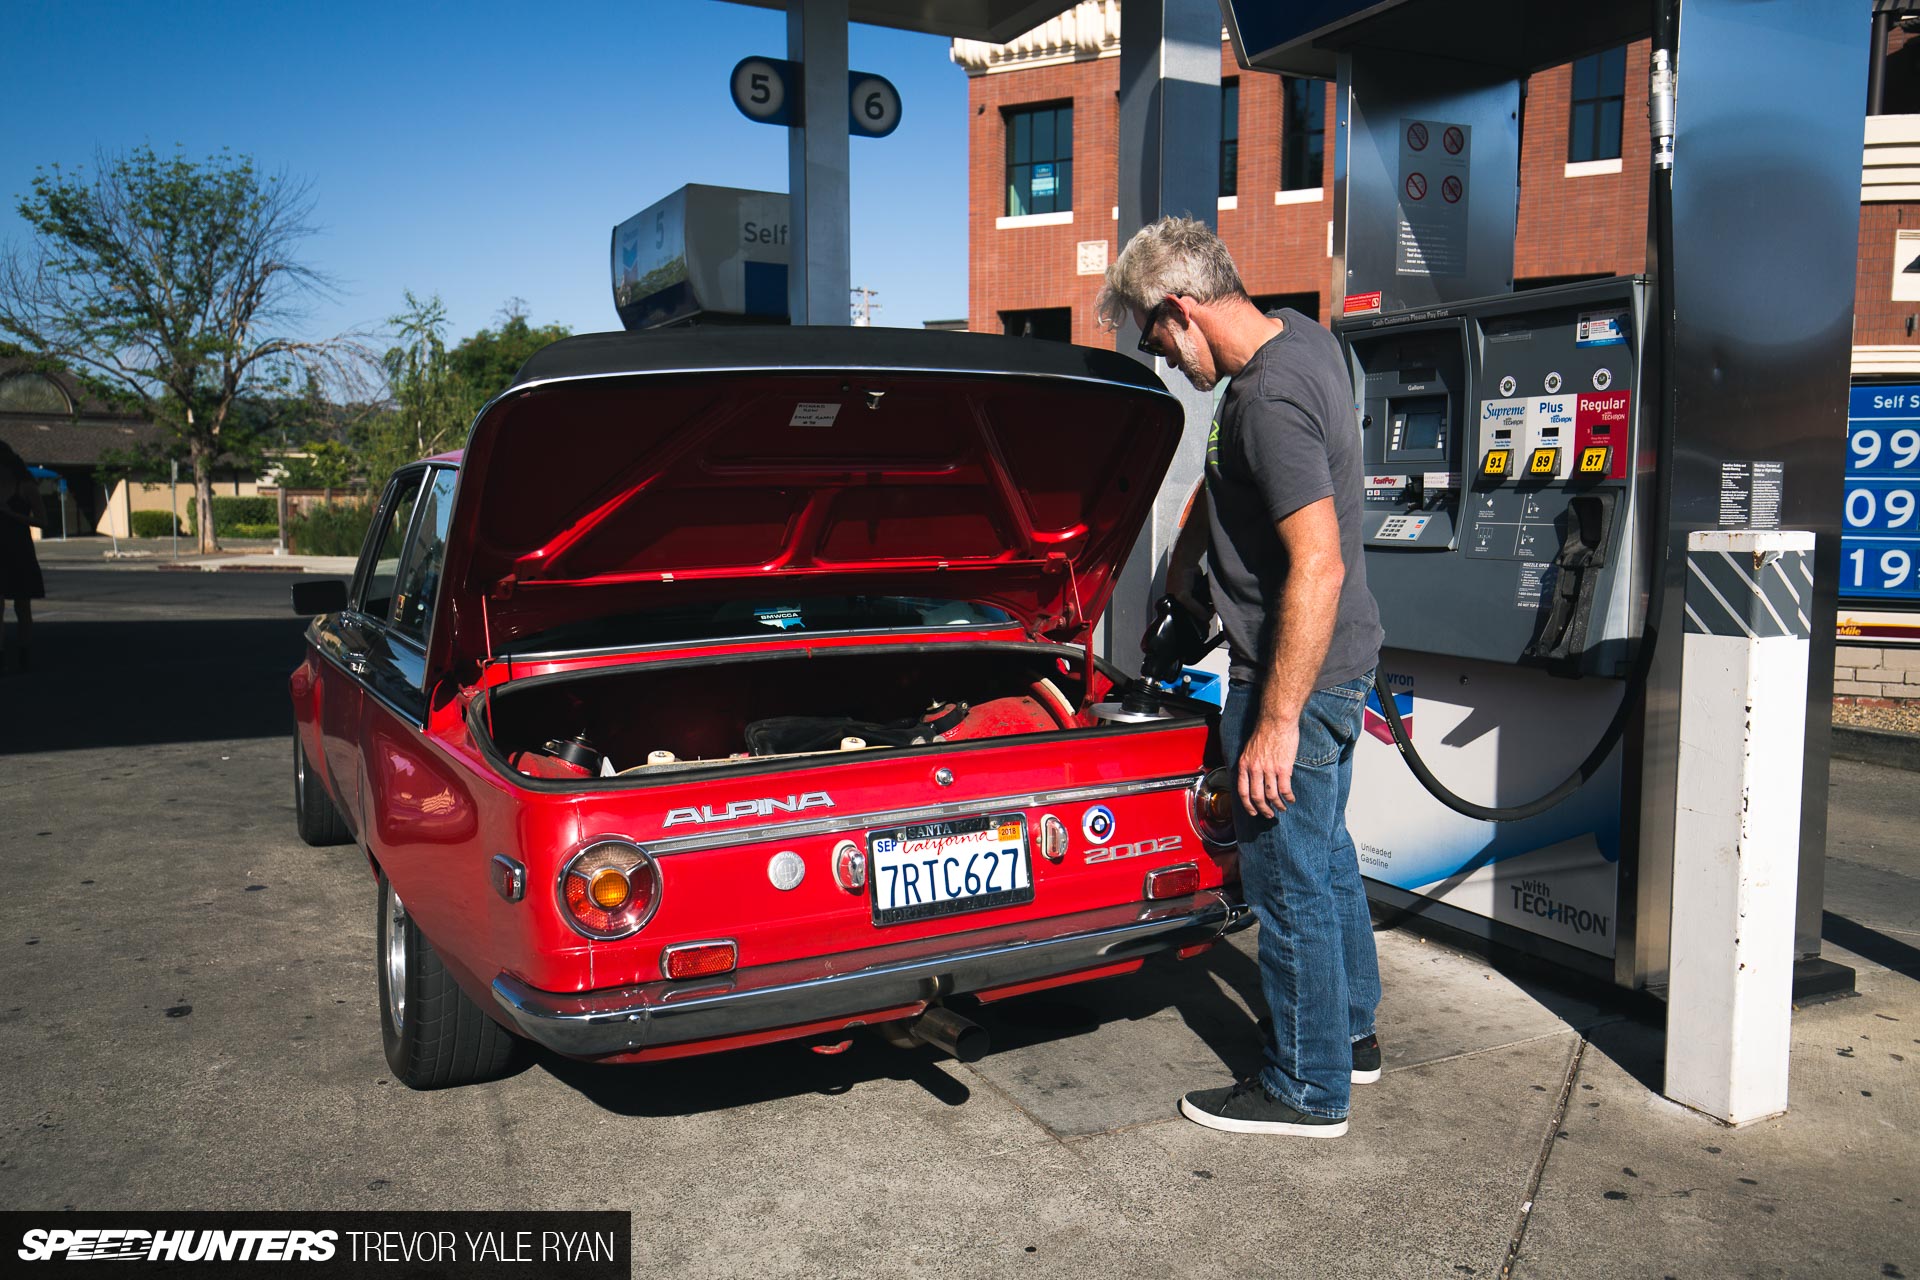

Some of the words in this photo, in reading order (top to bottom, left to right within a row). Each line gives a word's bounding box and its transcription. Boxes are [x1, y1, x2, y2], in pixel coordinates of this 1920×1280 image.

[749, 73, 770, 104] 5
[864, 92, 884, 120] 6
[656, 210, 665, 250] 5
[744, 222, 787, 246] Self
[1539, 402, 1563, 414] Plus
[1580, 398, 1625, 414] Regular
[1873, 395, 1904, 409] Self
[1483, 402, 1525, 420] Supreme
[1851, 429, 1920, 468] 99
[1489, 457, 1501, 468] 91
[1536, 456, 1550, 467] 89
[1586, 455, 1601, 466] 87
[1373, 477, 1397, 486] FastPay
[1846, 488, 1916, 528] 09
[1850, 549, 1911, 588] 19
[662, 791, 836, 828] ALPINA
[908, 823, 952, 838] SANTA
[1001, 827, 1016, 836] 2018
[877, 840, 897, 853] SEP
[1083, 836, 1182, 864] 2002
[1360, 843, 1392, 859] Unleaded
[1360, 855, 1389, 869] Gasoline
[881, 848, 1018, 907] 7RTC627
[1522, 880, 1550, 897] with
[1510, 885, 1607, 936] TECHRON
